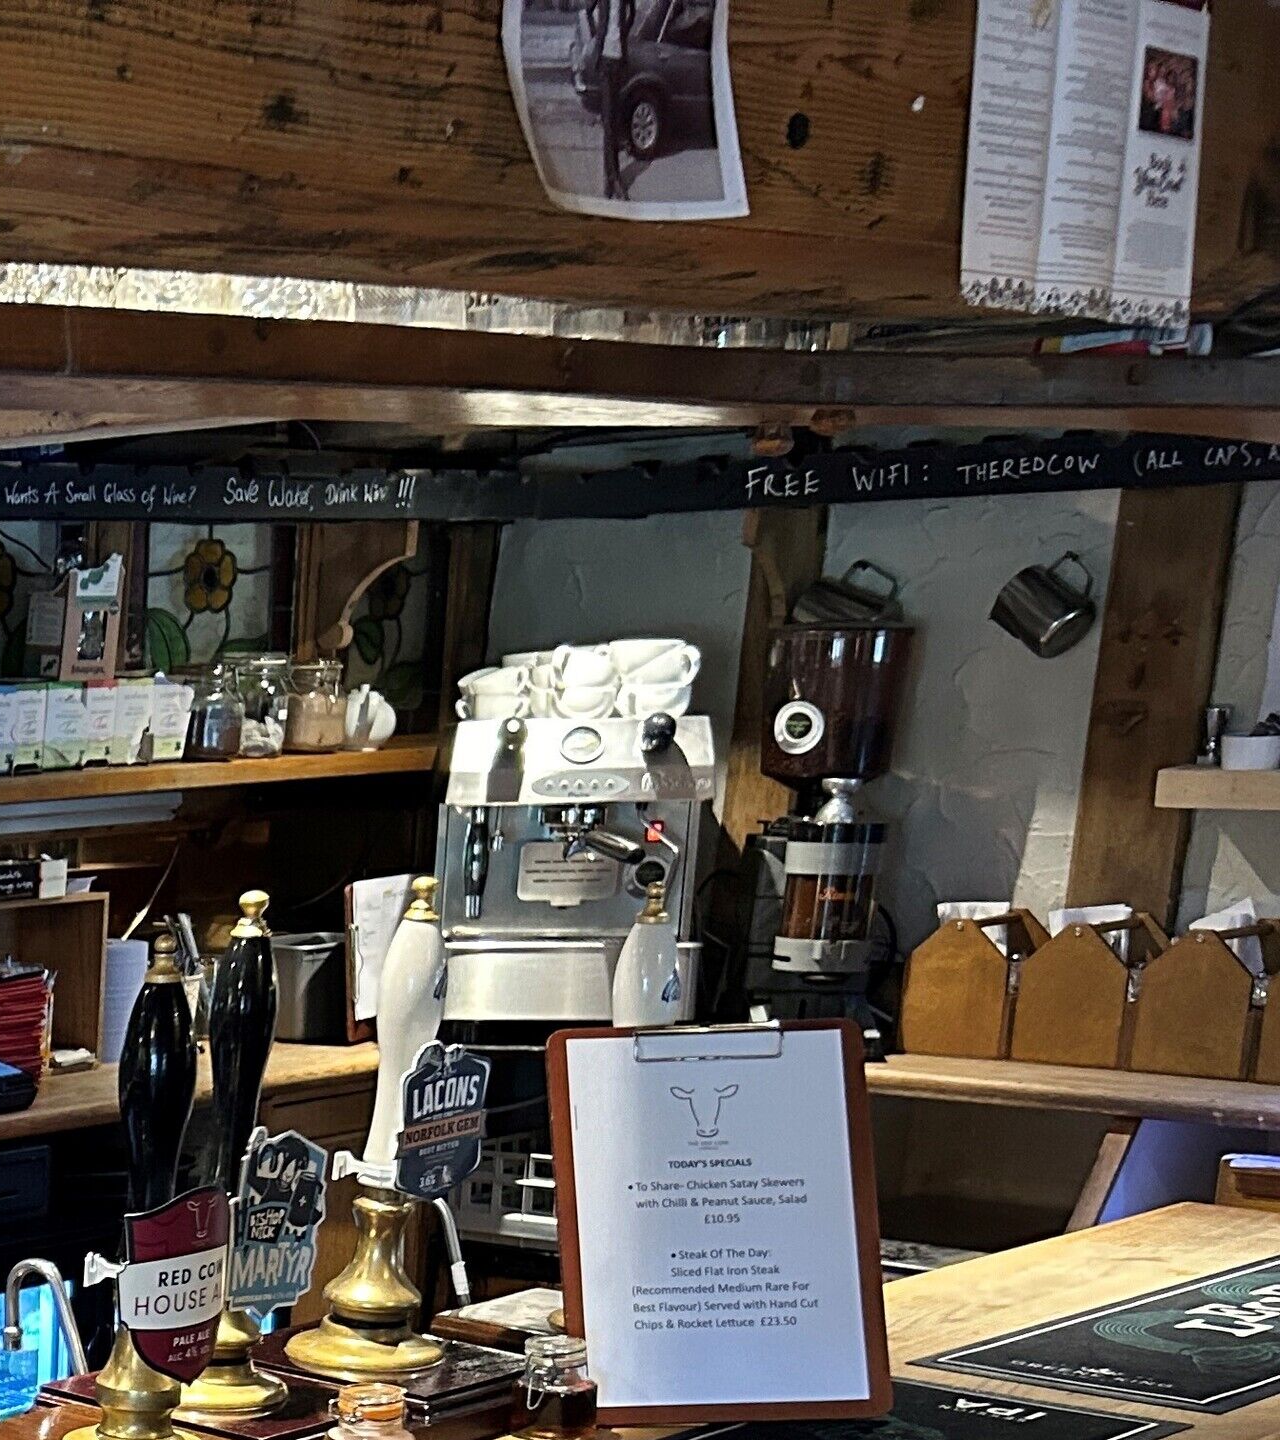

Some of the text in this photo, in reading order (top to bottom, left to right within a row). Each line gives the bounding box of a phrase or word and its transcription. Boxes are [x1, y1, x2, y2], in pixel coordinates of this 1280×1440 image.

[745, 466, 821, 500] FREE
[852, 463, 930, 492] WIFI:
[957, 452, 1101, 487] THEREDCOW
[44, 480, 59, 504] A
[65, 478, 97, 504] Small
[103, 478, 137, 504] Glass
[141, 477, 156, 512] of
[223, 476, 259, 506] Save
[412, 1074, 480, 1119] LACONS
[404, 1116, 479, 1145] NORFOLK GEM
[668, 1158, 753, 1169] TODAY'S SPECIALS
[635, 1177, 805, 1192] To Share- Chicken Satay Skewers
[635, 1193, 808, 1209] with Chilli & Peanut Sauce, Salad
[249, 1207, 286, 1227] BISHOP
[704, 1213, 741, 1225] £10.95
[250, 1226, 276, 1240] NICK
[679, 1248, 707, 1259] Steak
[709, 1248, 723, 1258] Of
[726, 1248, 745, 1258] The
[158, 1268, 192, 1288] RED
[671, 1265, 780, 1277] Sliced Flat Iron Steak
[632, 1281, 810, 1297] (Recommended Medium Rare For
[134, 1286, 208, 1317] HOUSE
[632, 1298, 819, 1313] Best Flavour) Served with Hand Cut
[634, 1315, 797, 1331] Chips & Rocket Lettuce £23.50
[172, 1333, 195, 1348] PALE
